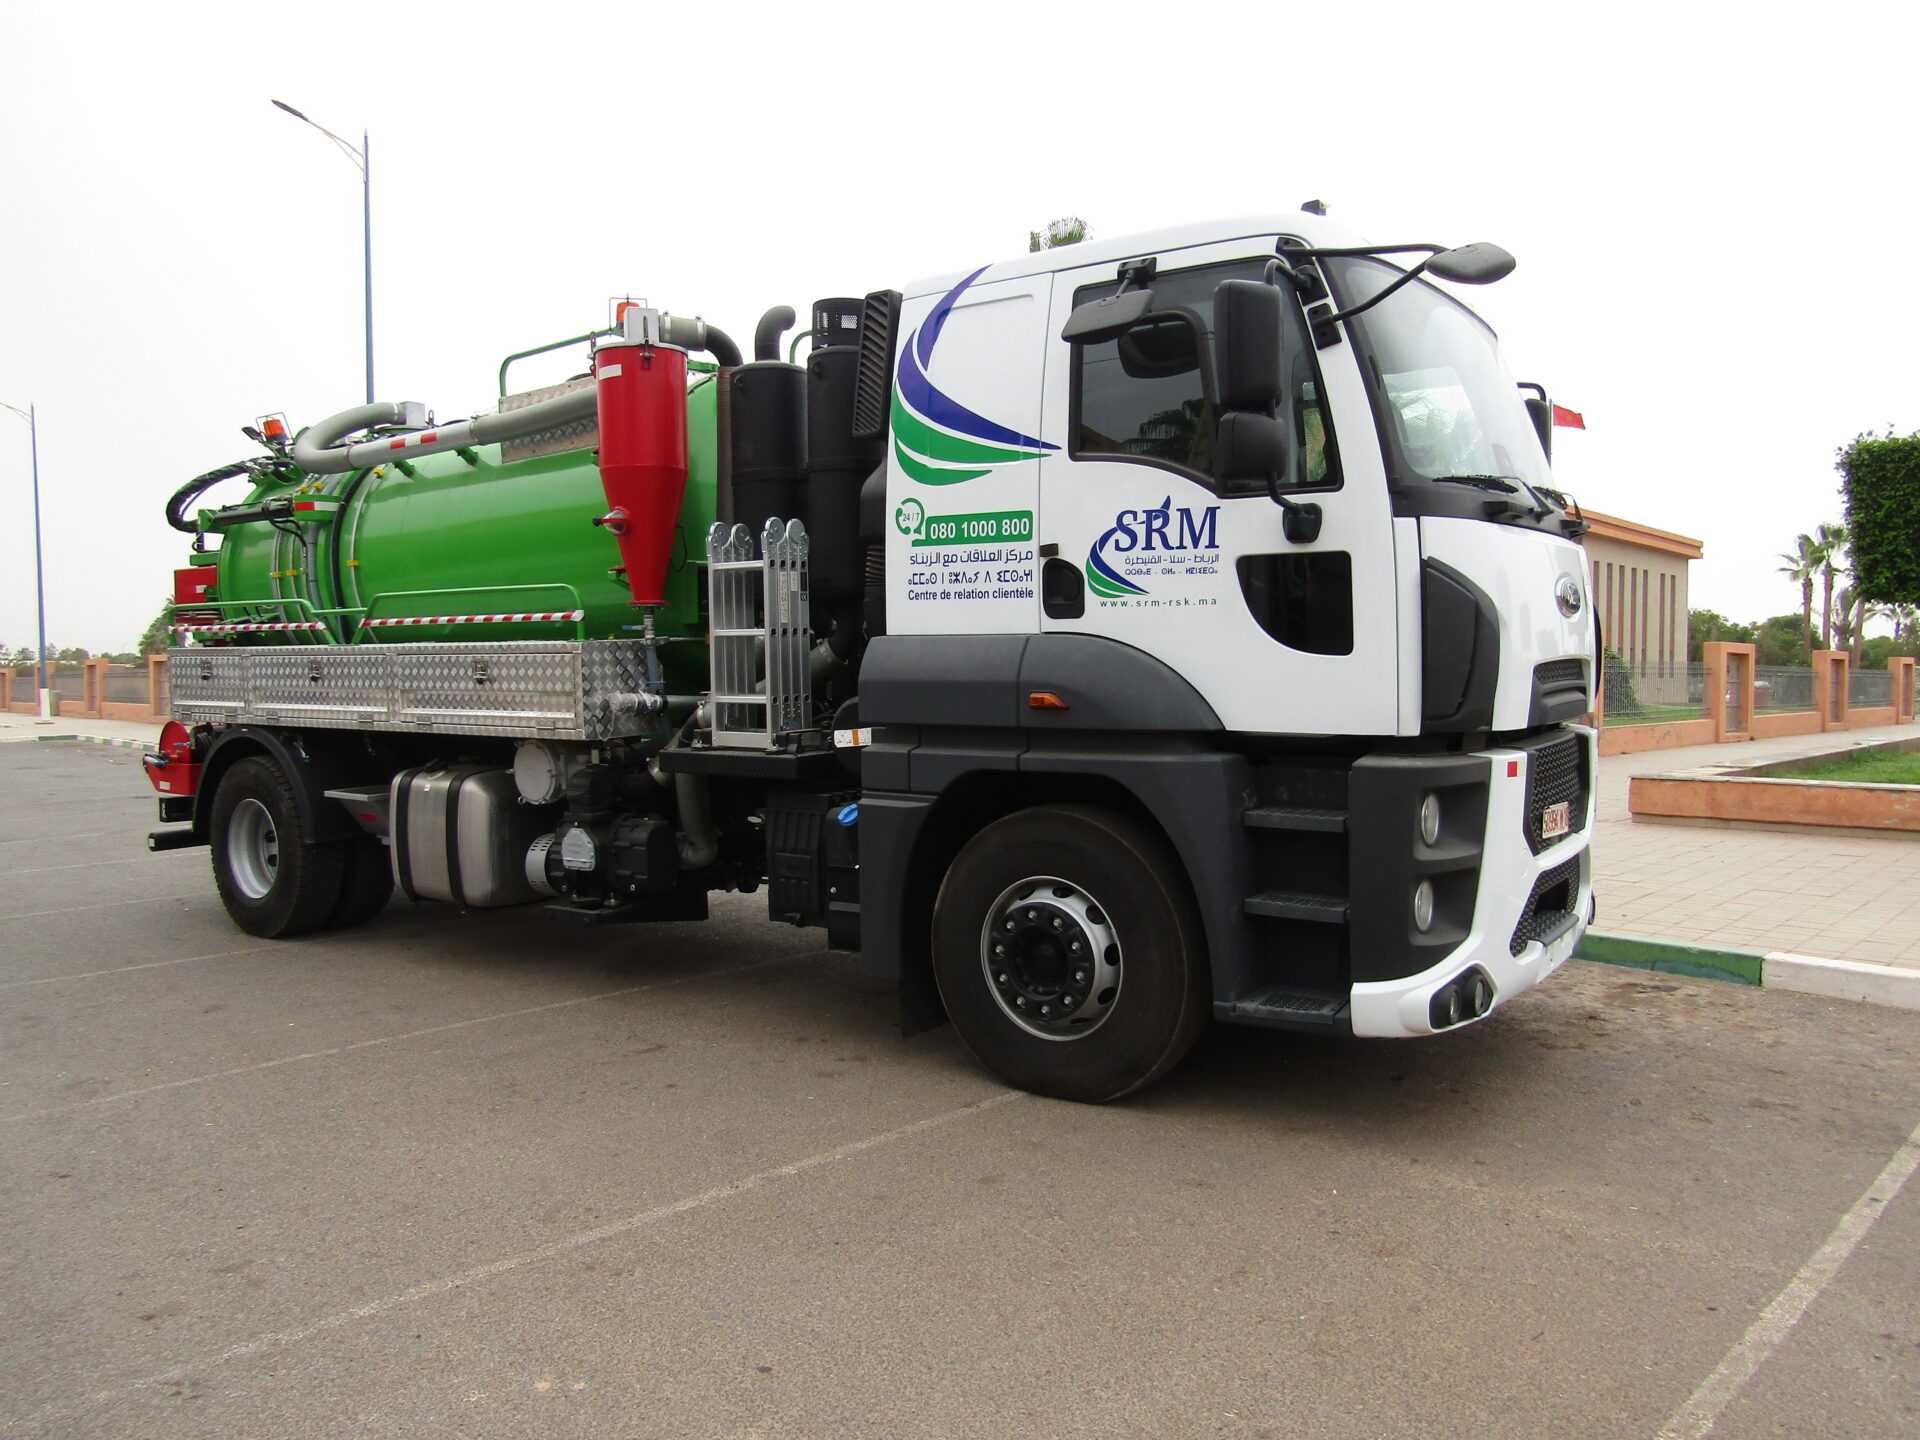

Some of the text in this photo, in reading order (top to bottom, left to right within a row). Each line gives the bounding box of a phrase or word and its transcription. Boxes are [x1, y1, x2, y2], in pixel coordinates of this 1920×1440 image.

[930, 517, 1030, 540] 080 1000 800
[1114, 504, 1221, 553] SRM
[909, 548, 1033, 567] مركز العلاقات مع الزبناء
[1124, 555, 1162, 567] القنيطرة
[1169, 554, 1185, 564] سلا
[1193, 553, 1220, 565] الرباط
[908, 586, 1034, 601] Centre de relation clientèle
[1099, 597, 1218, 608] www.srm-rsk.ma
